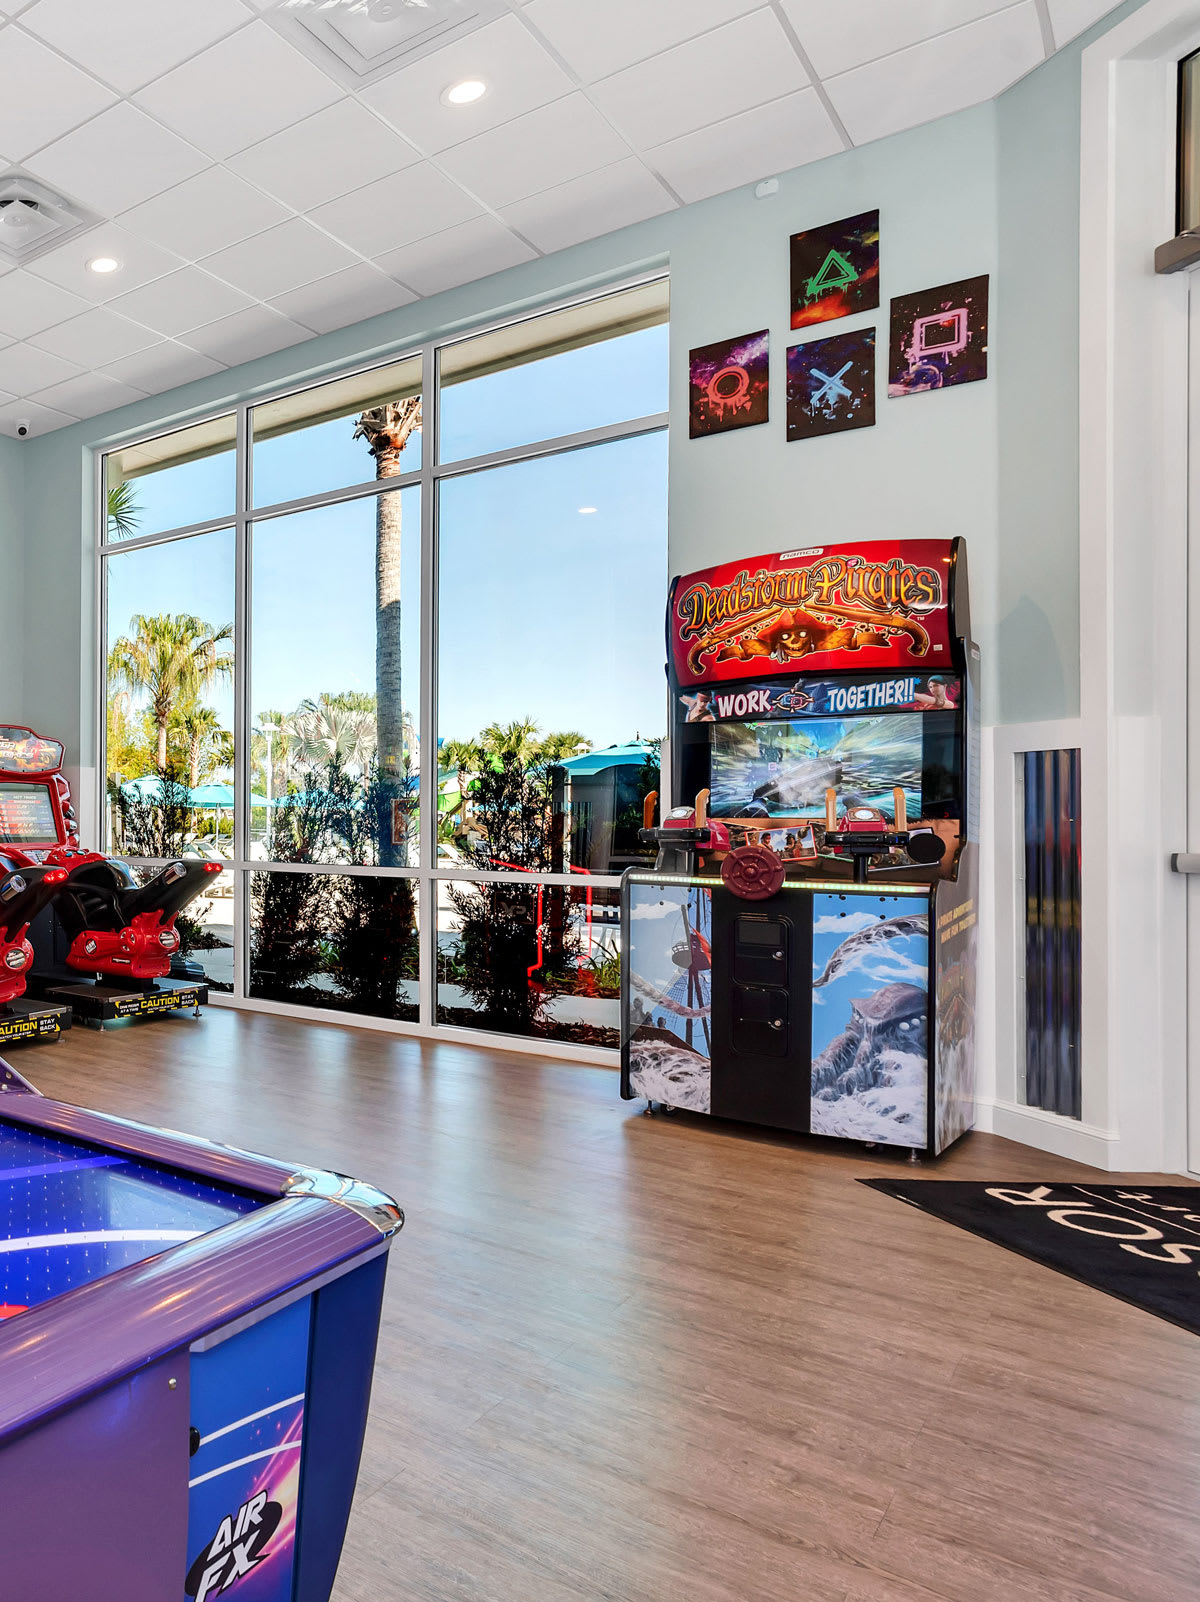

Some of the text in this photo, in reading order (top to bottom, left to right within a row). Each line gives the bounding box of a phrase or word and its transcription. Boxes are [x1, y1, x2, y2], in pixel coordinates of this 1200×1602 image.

[680, 557, 940, 637] Deadstorm Pirates
[718, 678, 915, 718] WORK TOGETHER!!
[40, 1018, 55, 1026] STAY
[141, 996, 180, 1009] CAUTION
[206, 1490, 267, 1562] AIR
[194, 1529, 261, 1602] FX
